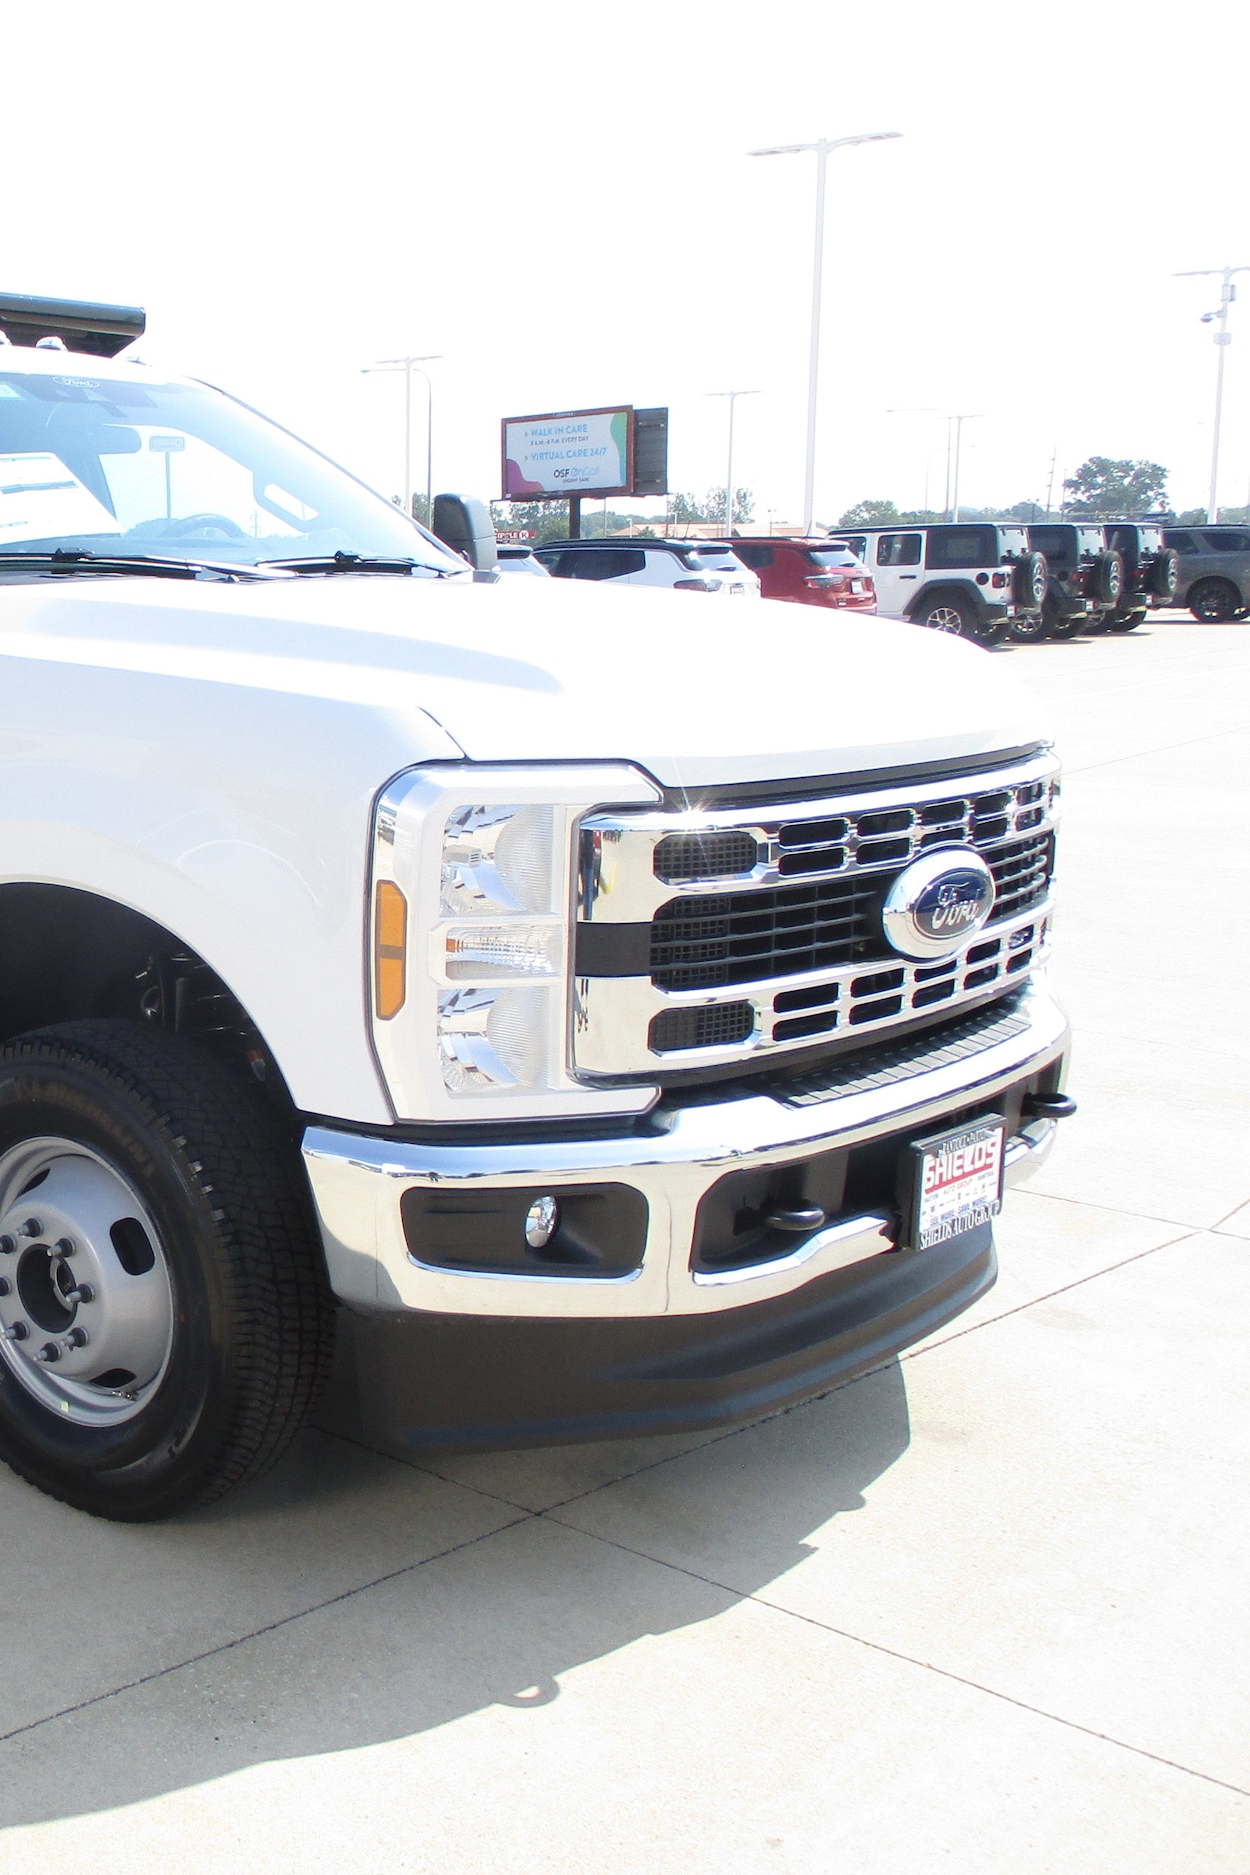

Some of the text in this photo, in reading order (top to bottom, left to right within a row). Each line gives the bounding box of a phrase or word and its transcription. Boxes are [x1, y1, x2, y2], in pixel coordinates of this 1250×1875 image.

[531, 424, 588, 436] WALK IN CARE
[530, 447, 607, 461] VIRTUAL CARE 24/7
[553, 468, 570, 478] OSF
[924, 1142, 996, 1188] SHIELDS
[920, 1219, 952, 1250] SHIELDS
[952, 1210, 974, 1237] AUTO
